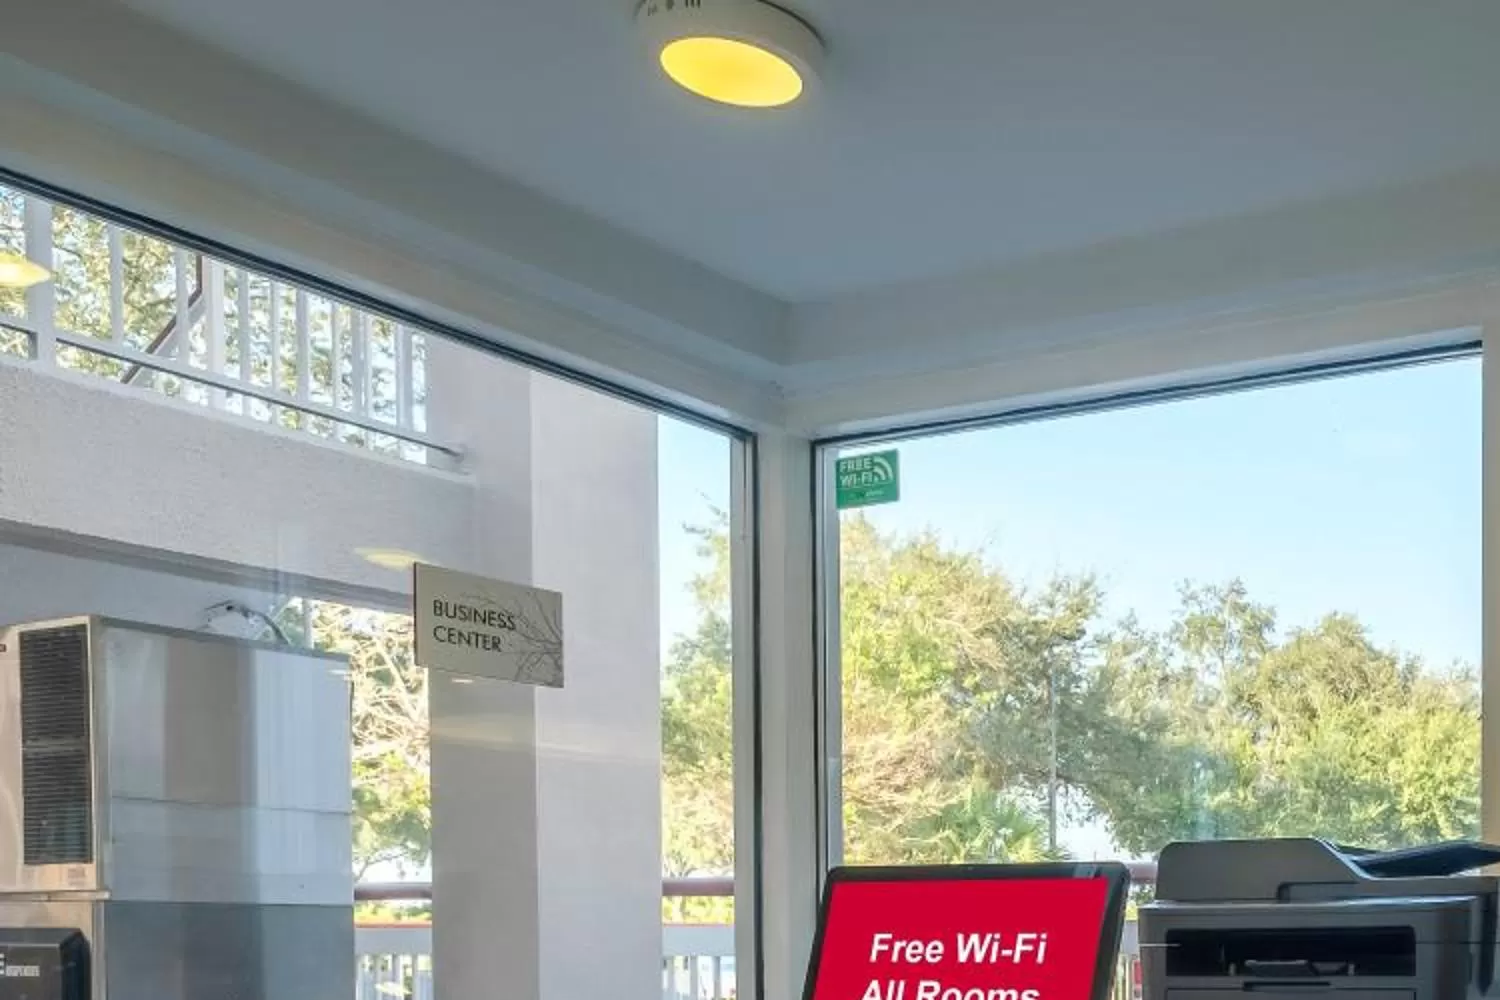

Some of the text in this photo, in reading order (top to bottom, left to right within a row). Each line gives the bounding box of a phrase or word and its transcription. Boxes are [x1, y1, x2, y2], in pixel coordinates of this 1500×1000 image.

[433, 599, 517, 631] BUSINESS
[433, 625, 502, 652] CENTER
[871, 934, 1046, 963] Free Wi-Fi
